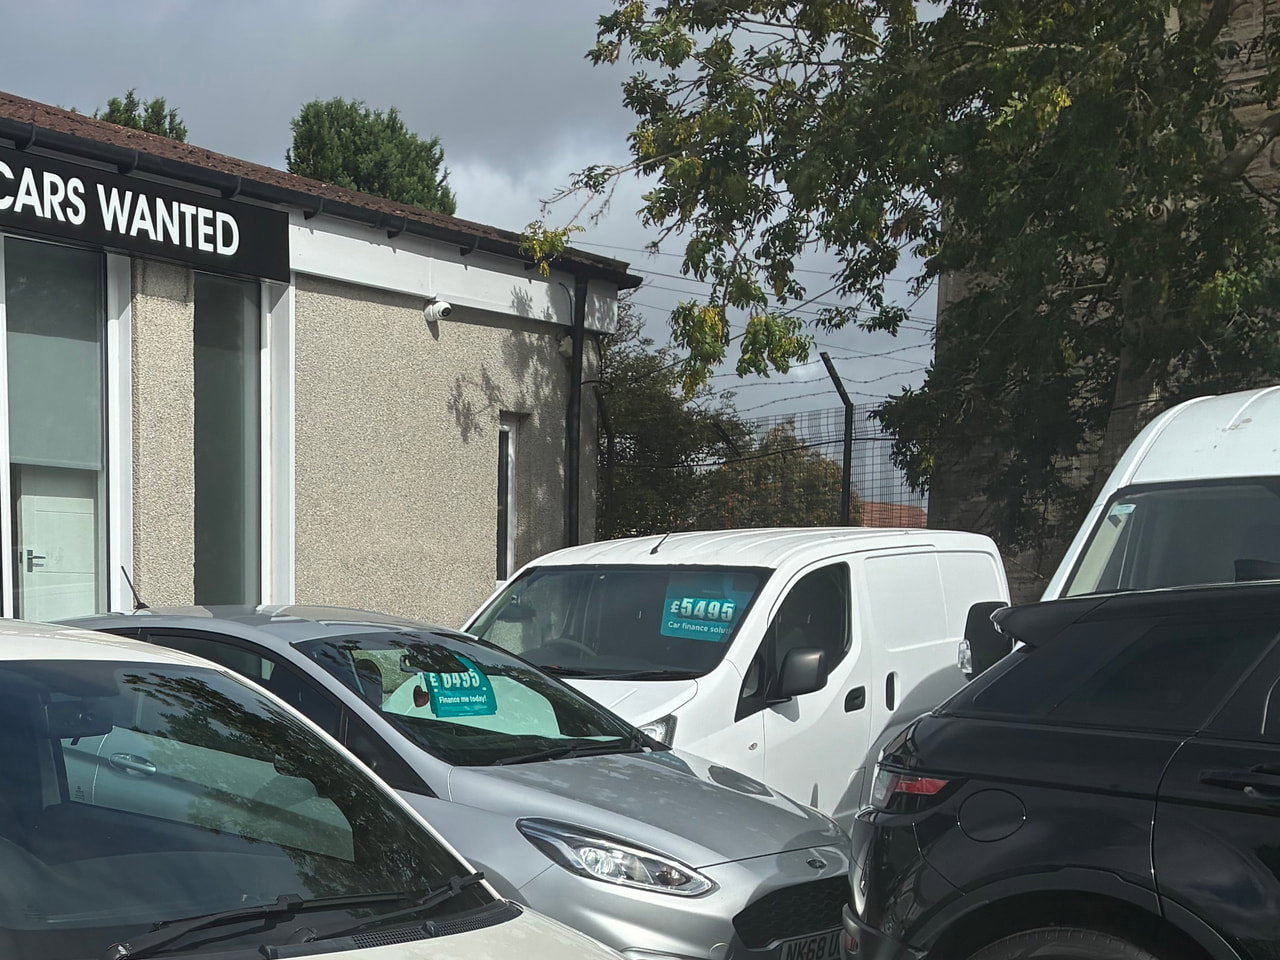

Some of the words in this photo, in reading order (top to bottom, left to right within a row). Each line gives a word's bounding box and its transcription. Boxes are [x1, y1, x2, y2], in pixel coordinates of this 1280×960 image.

[96, 183, 240, 257] WANTED
[670, 597, 735, 621] £5495
[668, 621, 680, 629] Car
[681, 623, 709, 633] finance
[438, 696, 461, 704] Finance
[470, 694, 487, 704] today!
